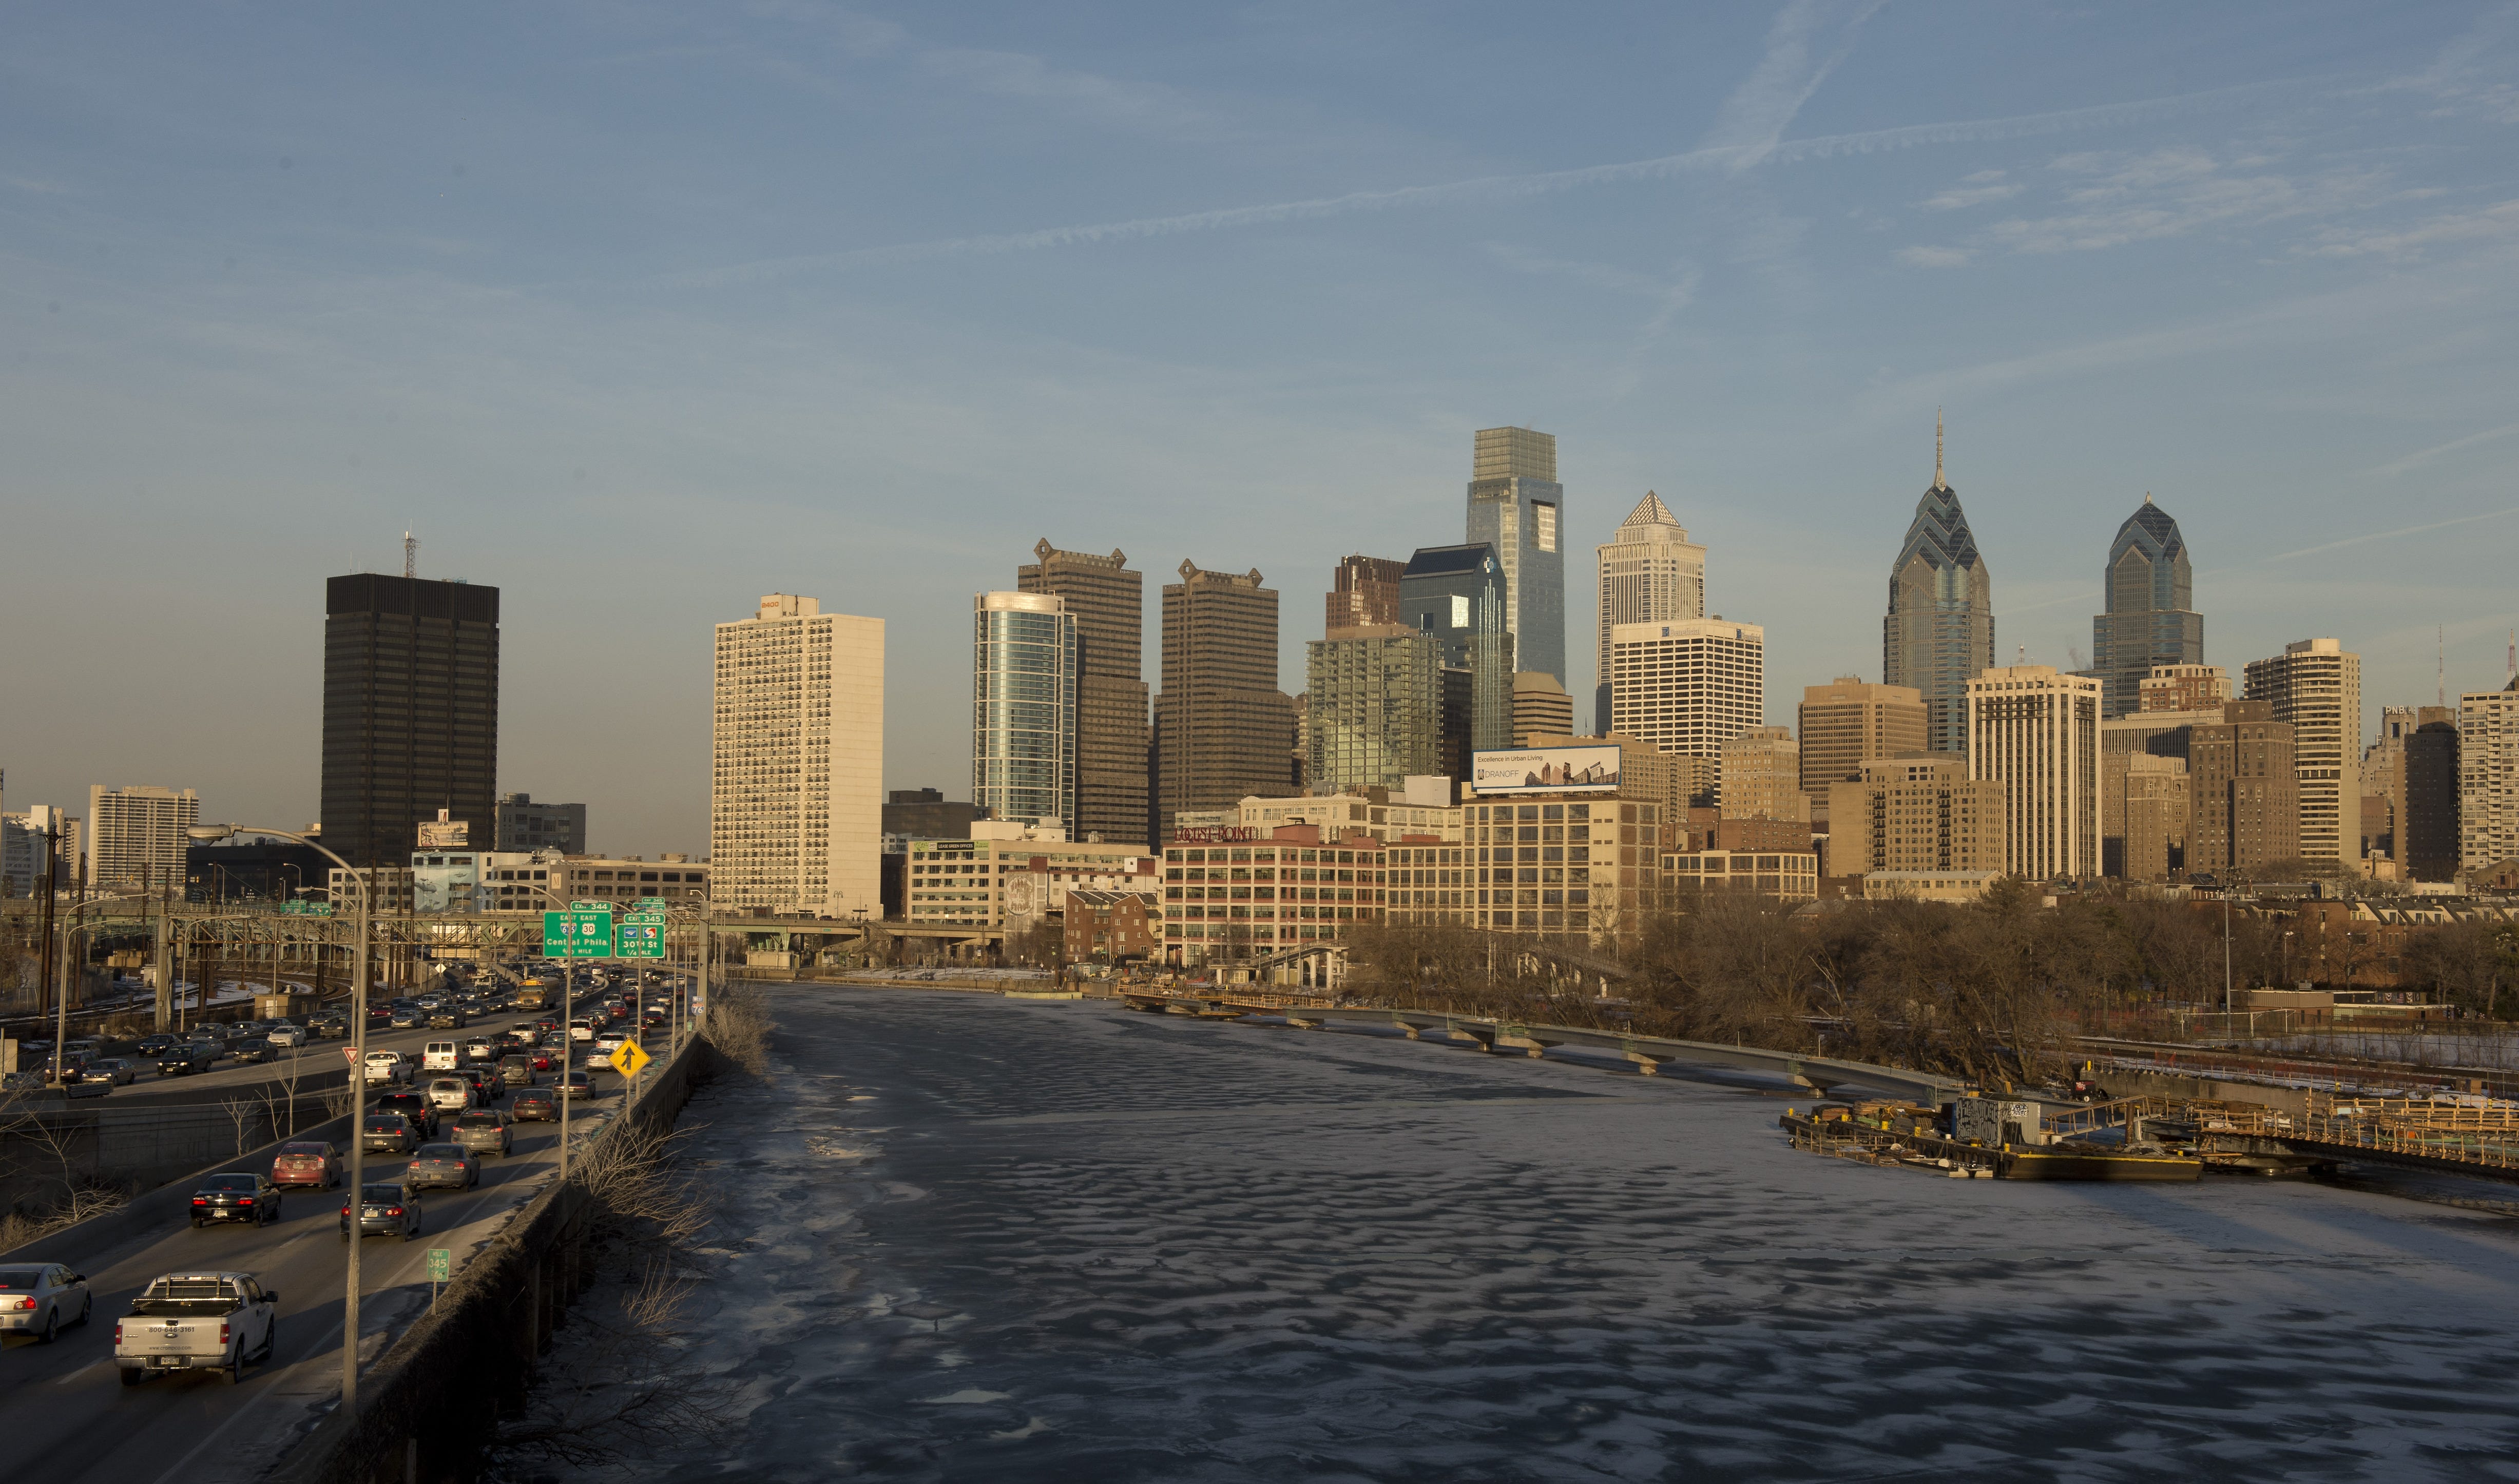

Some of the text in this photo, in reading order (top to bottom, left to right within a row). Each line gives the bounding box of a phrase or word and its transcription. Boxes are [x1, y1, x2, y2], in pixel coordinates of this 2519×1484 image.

[1670, 628, 1701, 637] Beneficial
[2386, 706, 2405, 715] PNB
[1175, 826, 1255, 841] LOCUST POINT
[429, 1259, 447, 1268] 345
